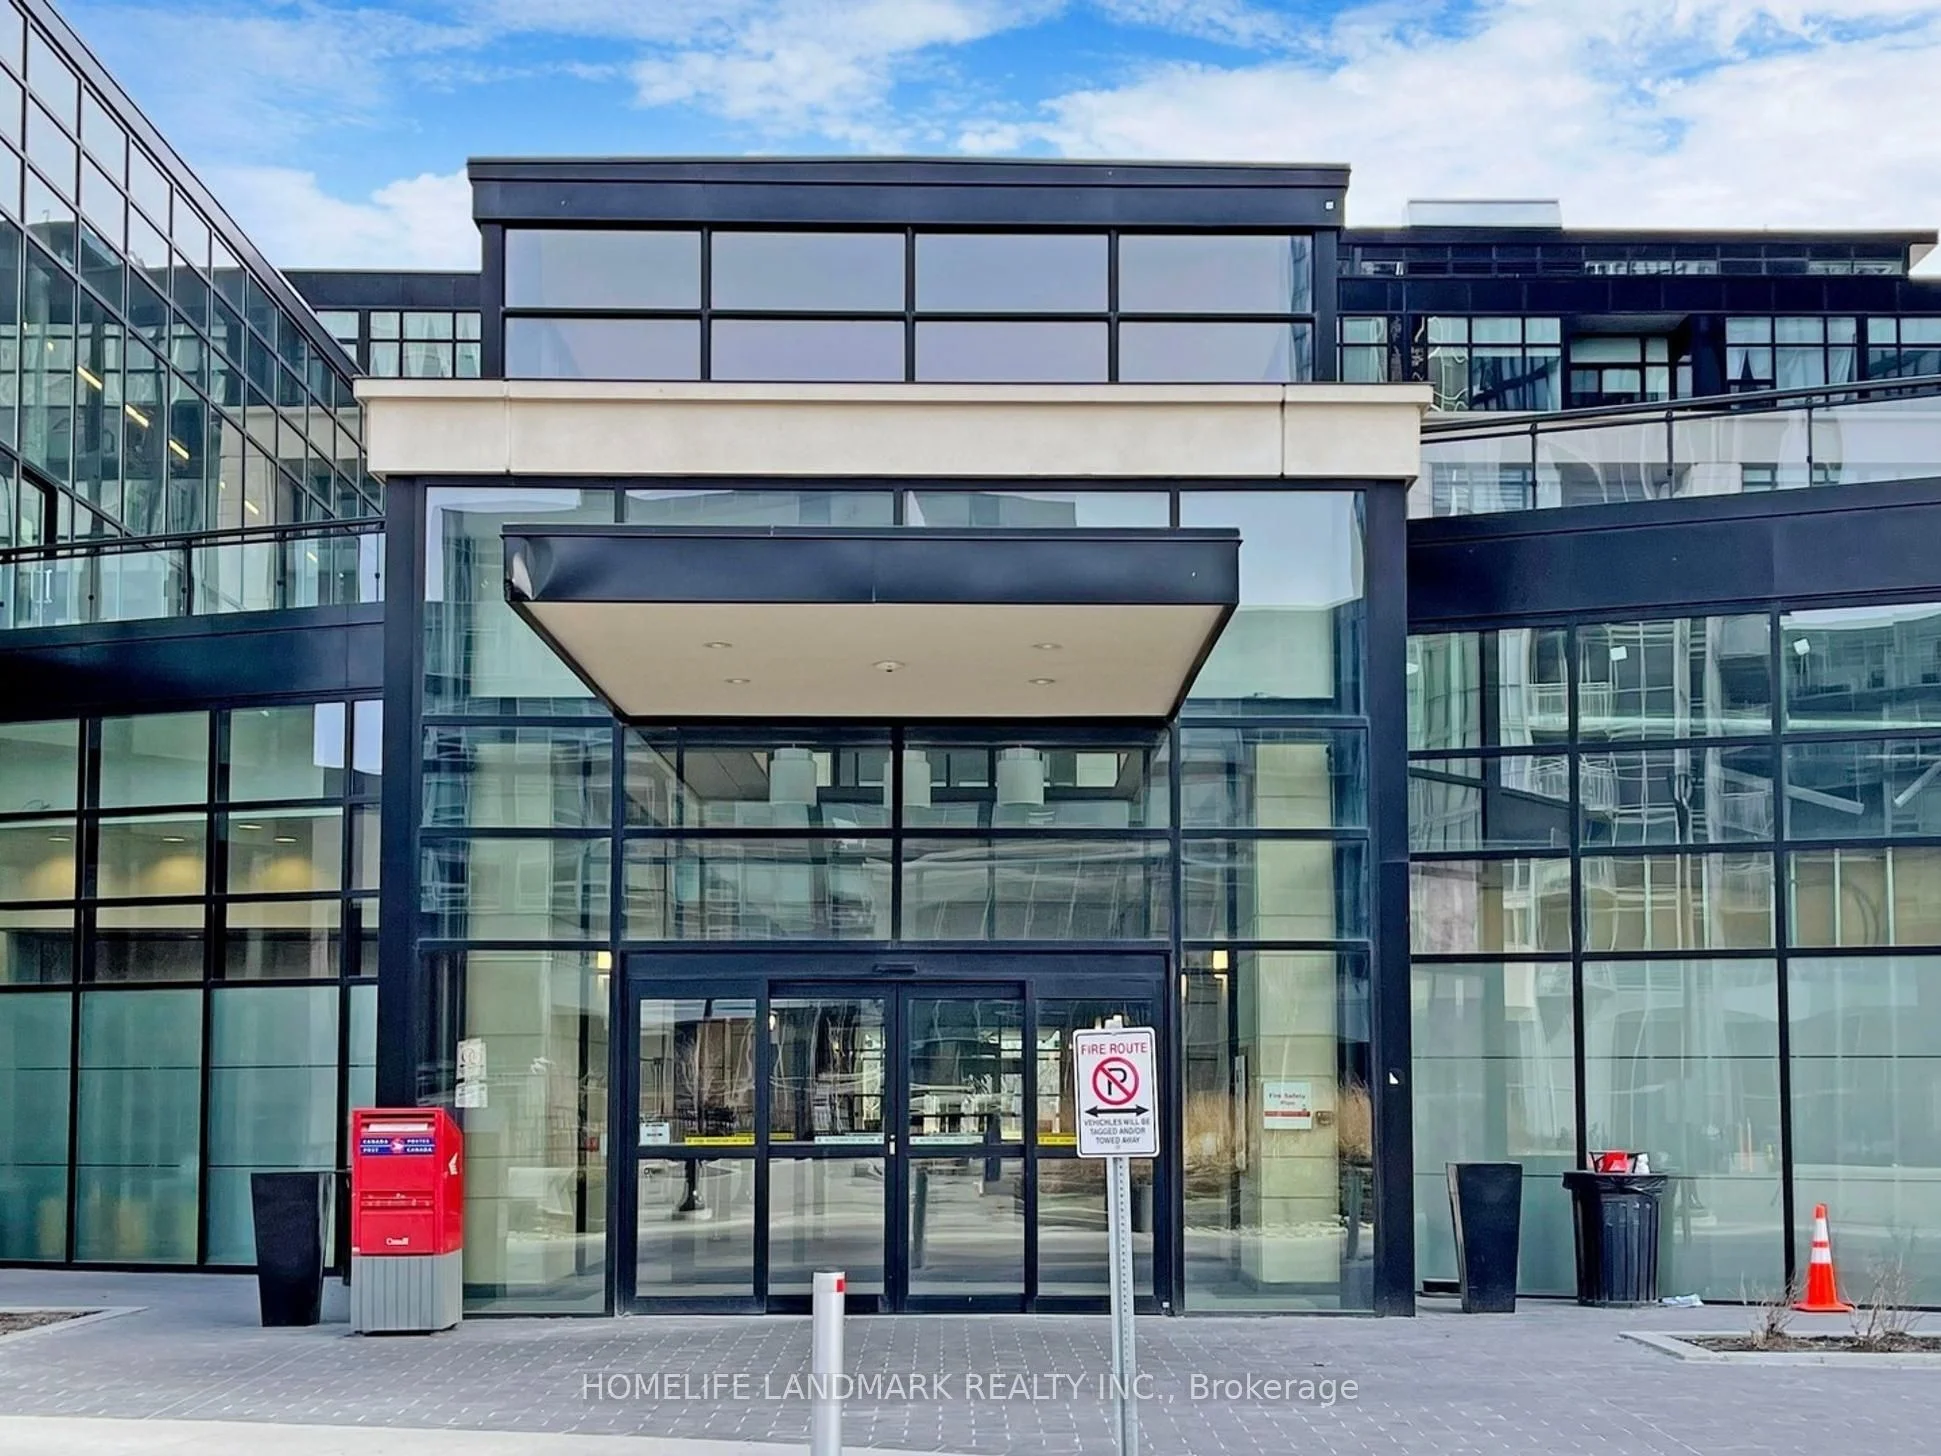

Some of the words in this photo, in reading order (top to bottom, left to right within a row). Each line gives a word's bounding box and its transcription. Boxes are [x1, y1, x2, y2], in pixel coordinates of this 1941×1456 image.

[1081, 1044, 1106, 1055] FIRE
[1110, 1043, 1147, 1054] ROUTE
[1123, 1118, 1139, 1126] WILL
[1090, 1127, 1118, 1135] TAGGED
[1096, 1136, 1120, 1144] TOWED
[1122, 1136, 1141, 1144] AWAY
